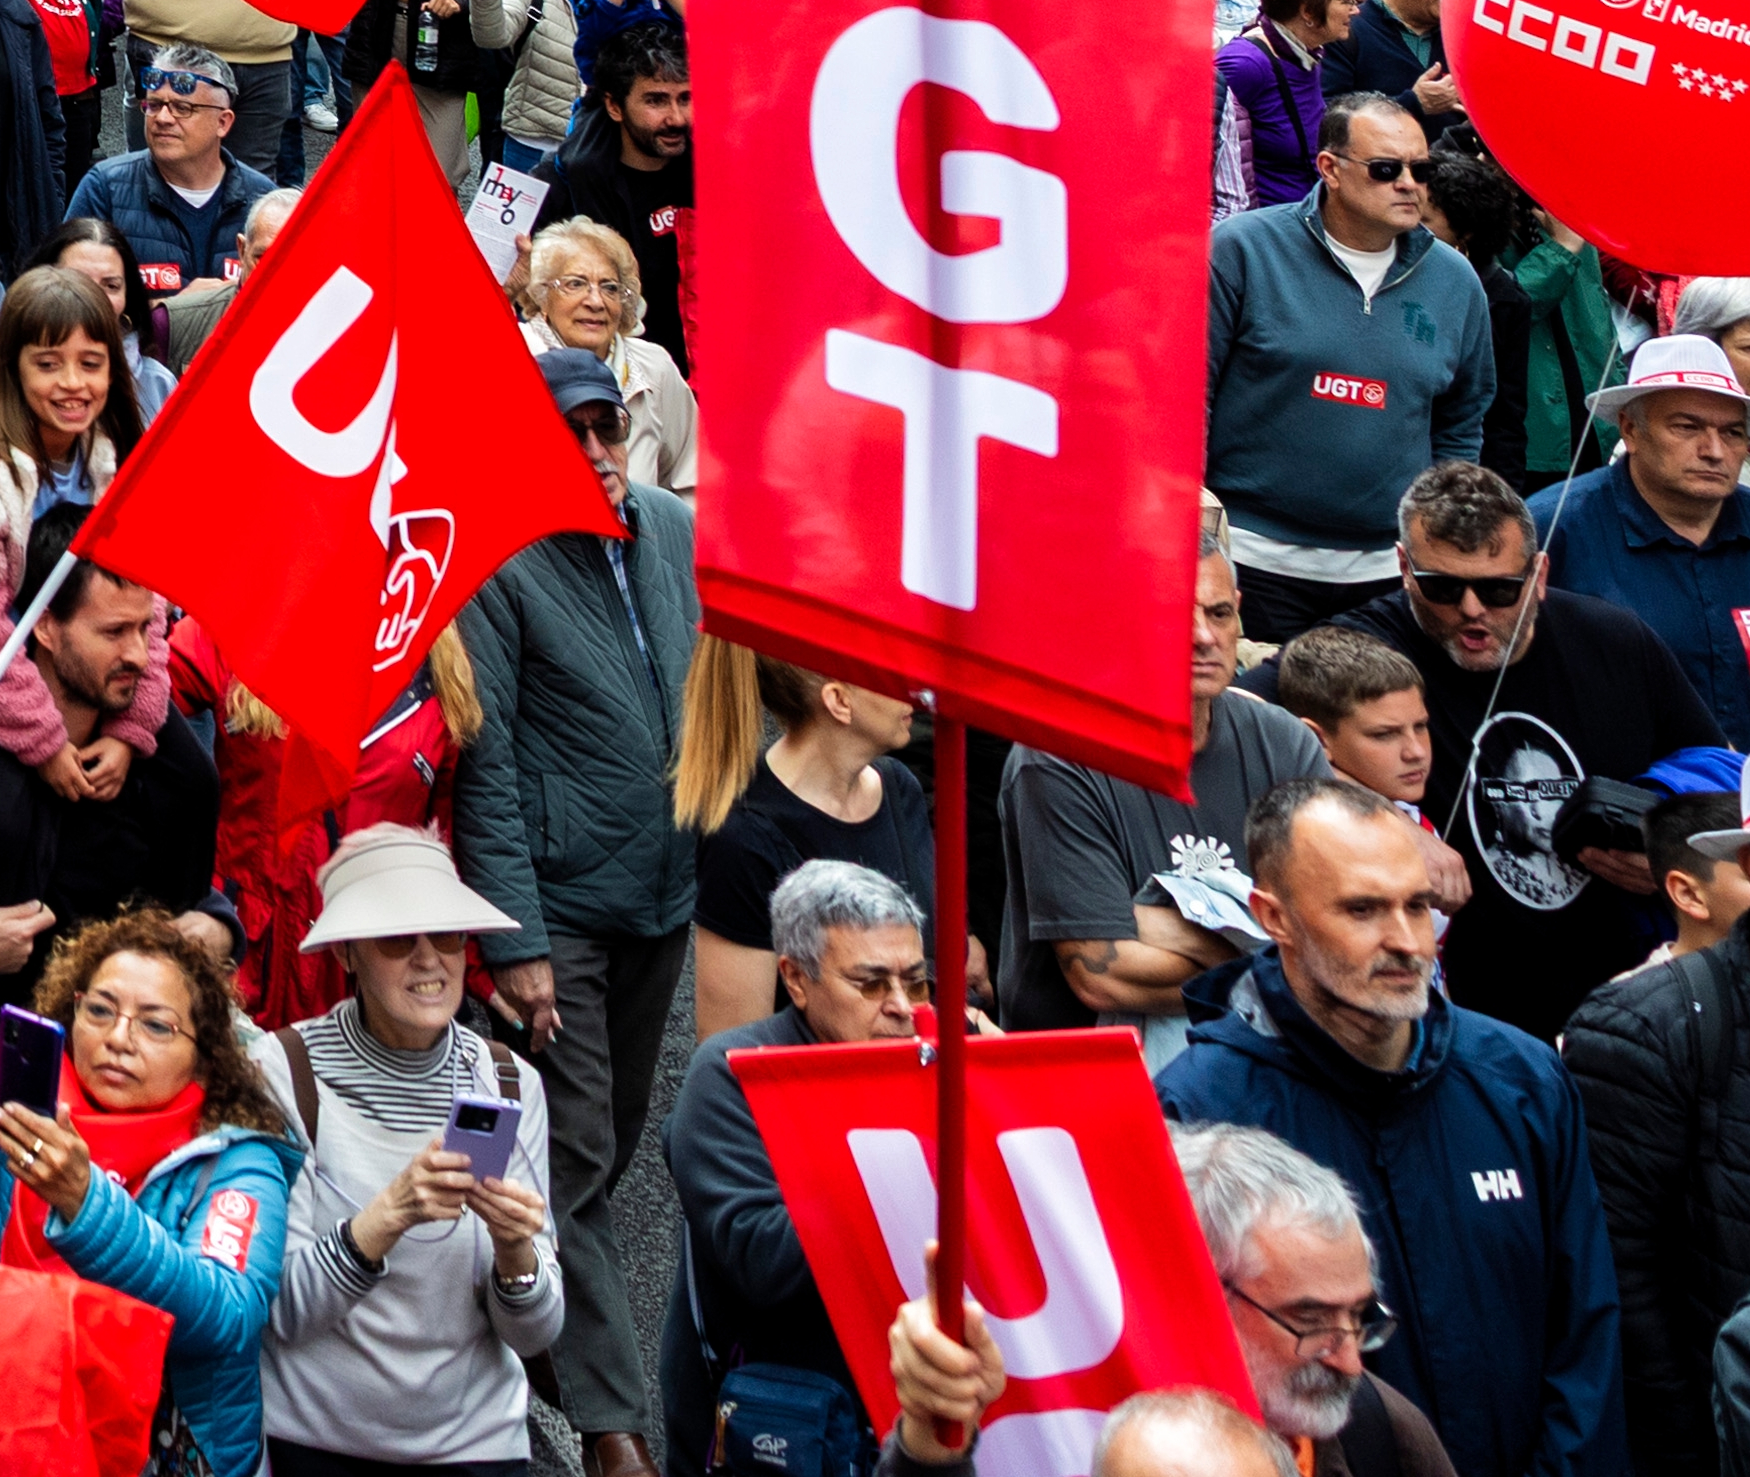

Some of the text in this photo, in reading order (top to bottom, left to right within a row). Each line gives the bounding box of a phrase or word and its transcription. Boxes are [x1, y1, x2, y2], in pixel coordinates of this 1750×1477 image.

[649, 209, 675, 232] UG
[1313, 374, 1364, 400] UGT
[1539, 782, 1579, 798] QUEEN
[1471, 1168, 1523, 1202] HH
